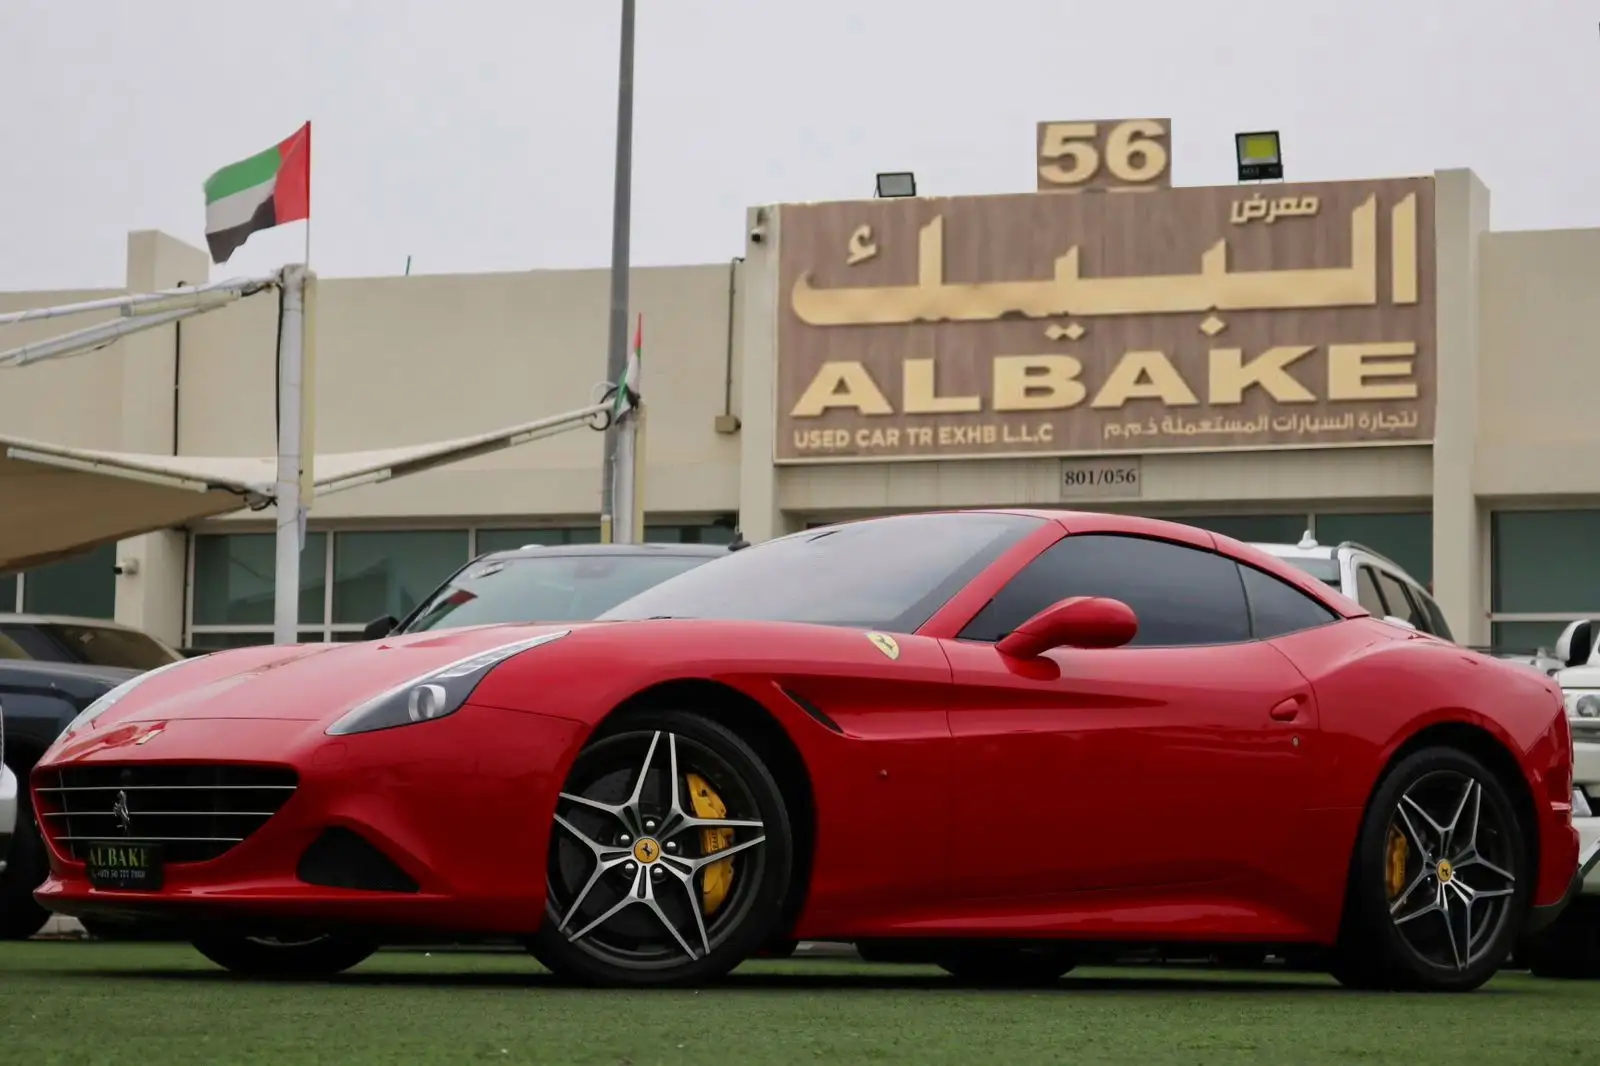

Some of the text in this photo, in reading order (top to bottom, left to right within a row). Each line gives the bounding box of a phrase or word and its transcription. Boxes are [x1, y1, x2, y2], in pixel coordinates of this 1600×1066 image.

[1038, 119, 1168, 184] 56
[1229, 193, 1319, 225] معرض
[789, 341, 1418, 417] ALBAKE
[1160, 414, 1268, 435] المستعملة
[1272, 412, 1354, 434] السيارات
[1358, 411, 1418, 431] لتجارة
[793, 422, 1054, 449] USED CAR TR EXHB L.L.C
[1064, 469, 1137, 486] 801/056
